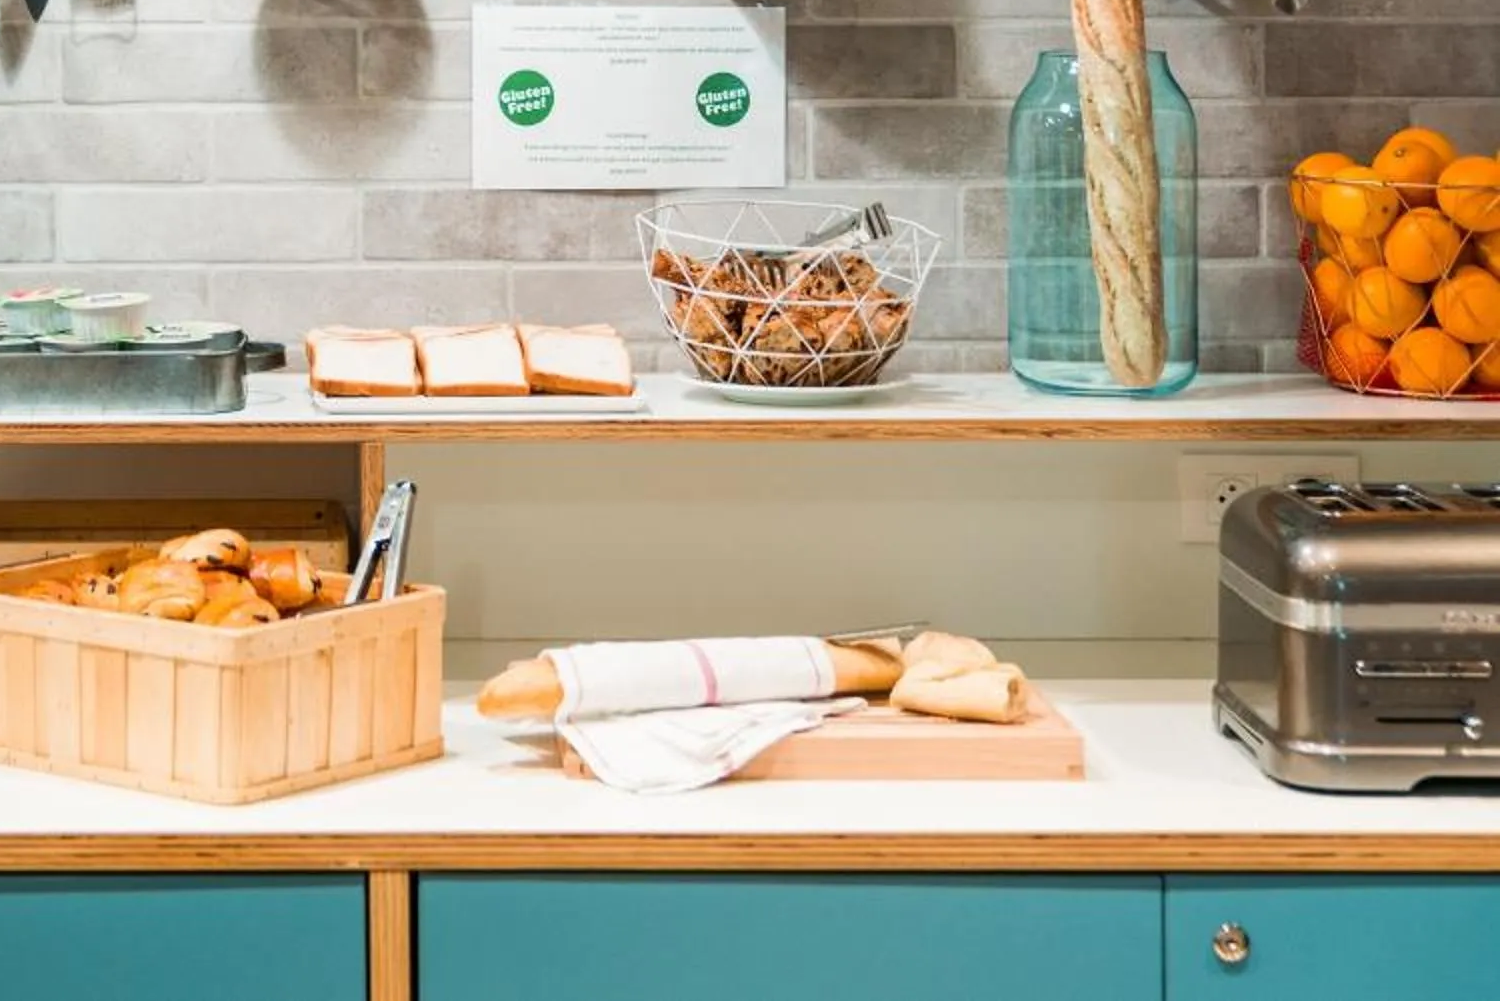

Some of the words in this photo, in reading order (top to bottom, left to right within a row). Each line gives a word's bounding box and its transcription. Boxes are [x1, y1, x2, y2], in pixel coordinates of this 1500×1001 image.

[501, 86, 550, 103] Gluten
[698, 89, 746, 104] Gluten
[508, 97, 546, 115] Free!
[706, 99, 742, 115] Free!
